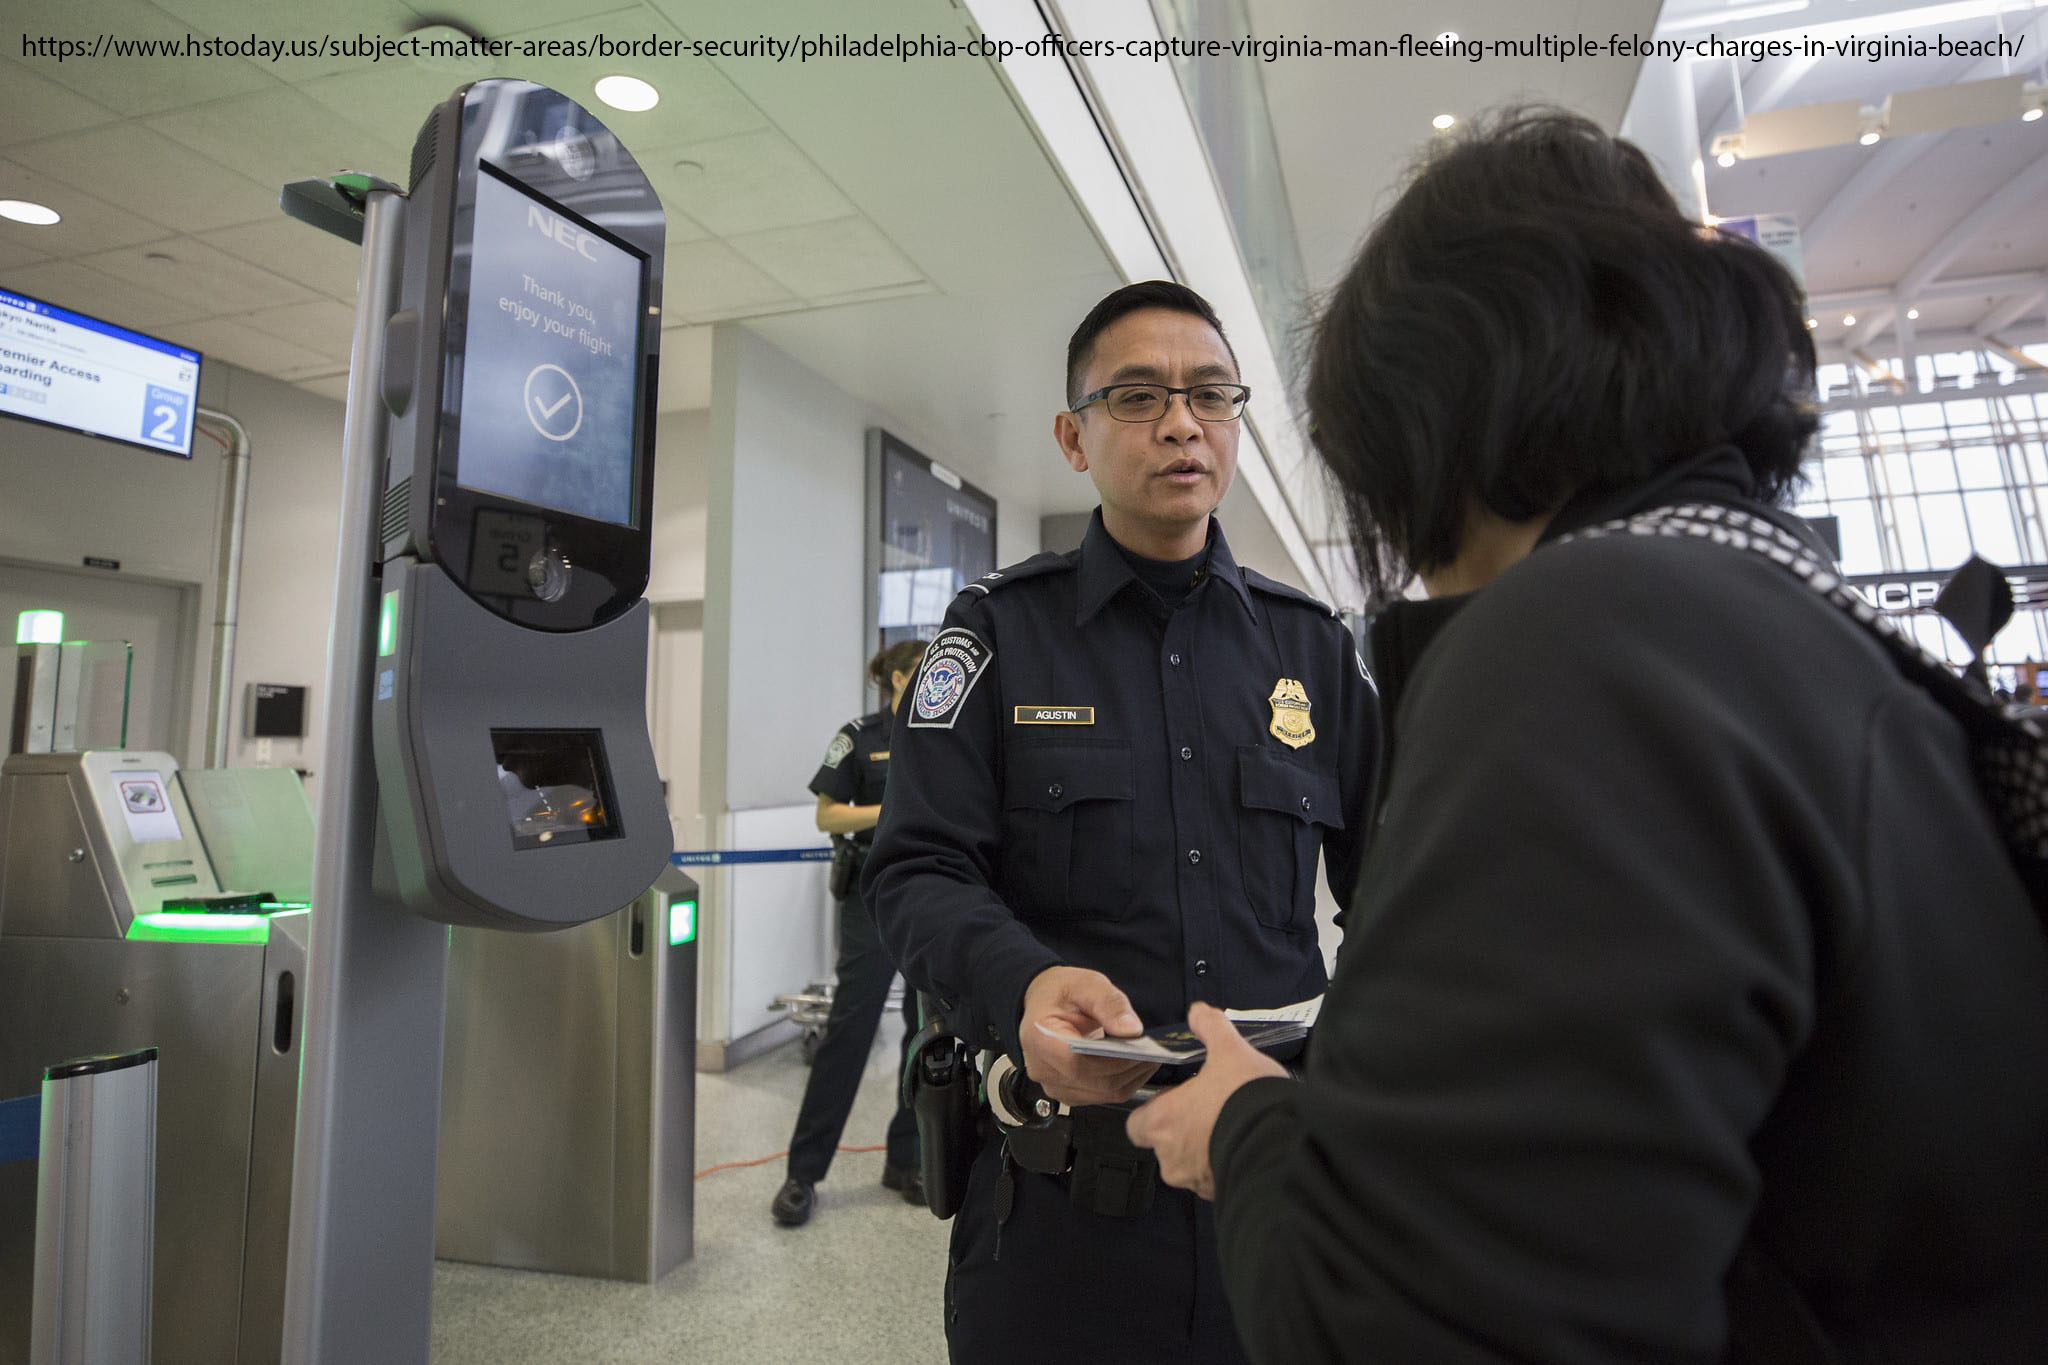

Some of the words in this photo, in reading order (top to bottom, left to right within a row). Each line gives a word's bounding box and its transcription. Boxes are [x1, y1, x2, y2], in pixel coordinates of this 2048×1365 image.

[527, 204, 599, 263] NEC
[522, 274, 565, 310] Thank
[567, 299, 597, 326] you,
[498, 296, 540, 328] enjoy
[543, 315, 577, 339] your
[579, 328, 613, 357] flight
[49, 360, 102, 383] Access
[150, 405, 178, 442] 2
[940, 636, 972, 649] CUSTOMS
[922, 649, 944, 673] BORDER
[944, 647, 977, 674] PROTECTION
[1035, 710, 1077, 720] AGUSTIN
